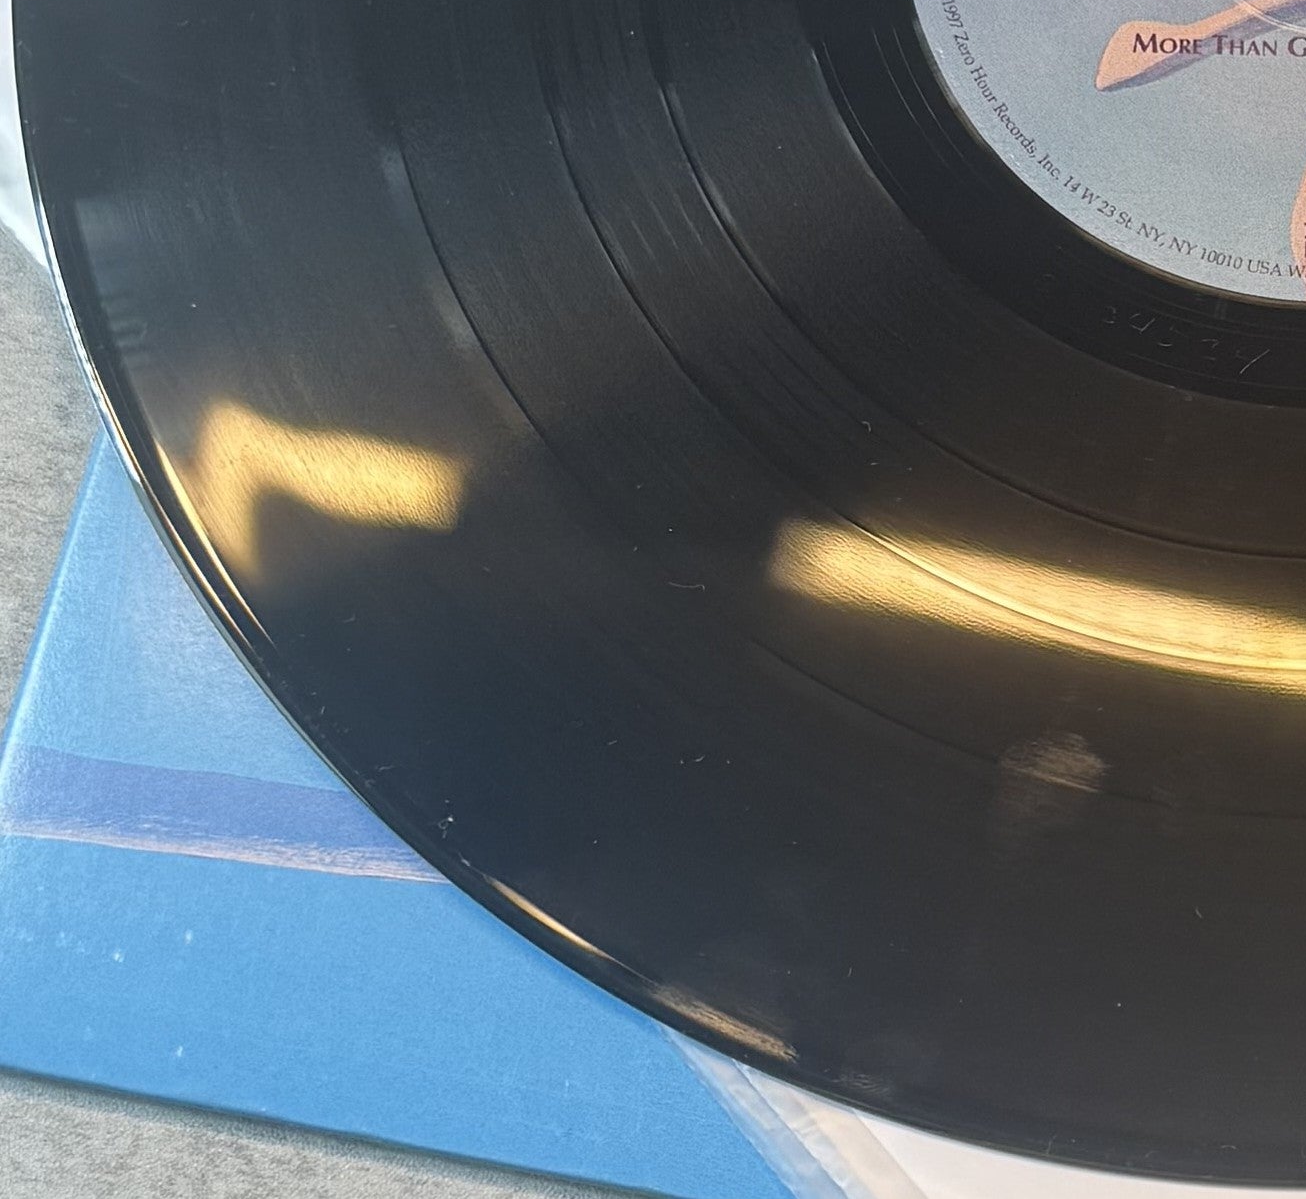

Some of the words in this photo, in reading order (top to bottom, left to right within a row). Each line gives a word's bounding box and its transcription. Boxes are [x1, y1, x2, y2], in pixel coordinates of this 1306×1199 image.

[1132, 32, 1201, 54] MORE
[1210, 34, 1277, 57] THAN
[954, 31, 975, 66] Zero
[970, 66, 998, 103] Hour
[993, 103, 1037, 158] Records,
[1063, 176, 1082, 193] 14
[1081, 187, 1100, 205] W
[1097, 201, 1117, 217] 23
[1137, 222, 1165, 247] NY,
[1169, 236, 1198, 255] NY
[1200, 248, 1243, 269] 10010
[1248, 259, 1282, 277] USA
